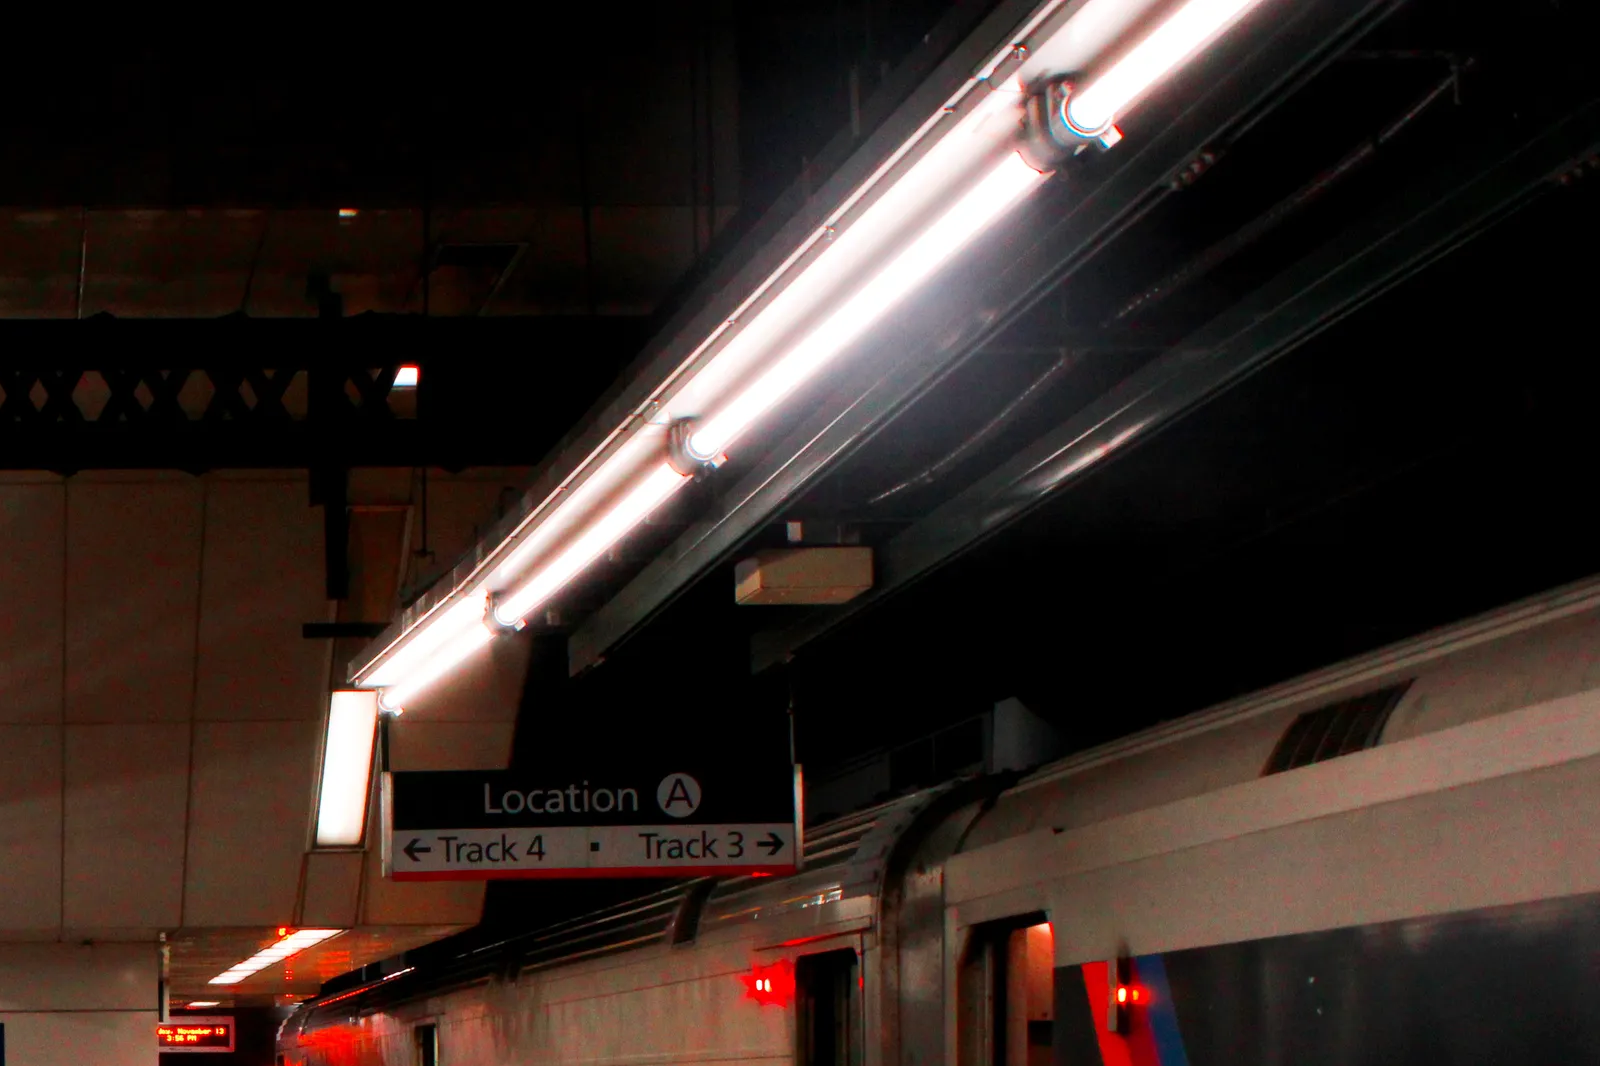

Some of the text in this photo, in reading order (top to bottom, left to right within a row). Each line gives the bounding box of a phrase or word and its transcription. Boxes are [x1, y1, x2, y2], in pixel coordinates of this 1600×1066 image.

[484, 778, 694, 814] Location A
[437, 831, 744, 863] Track 4 Track 3
[187, 1034, 198, 1042] PM
